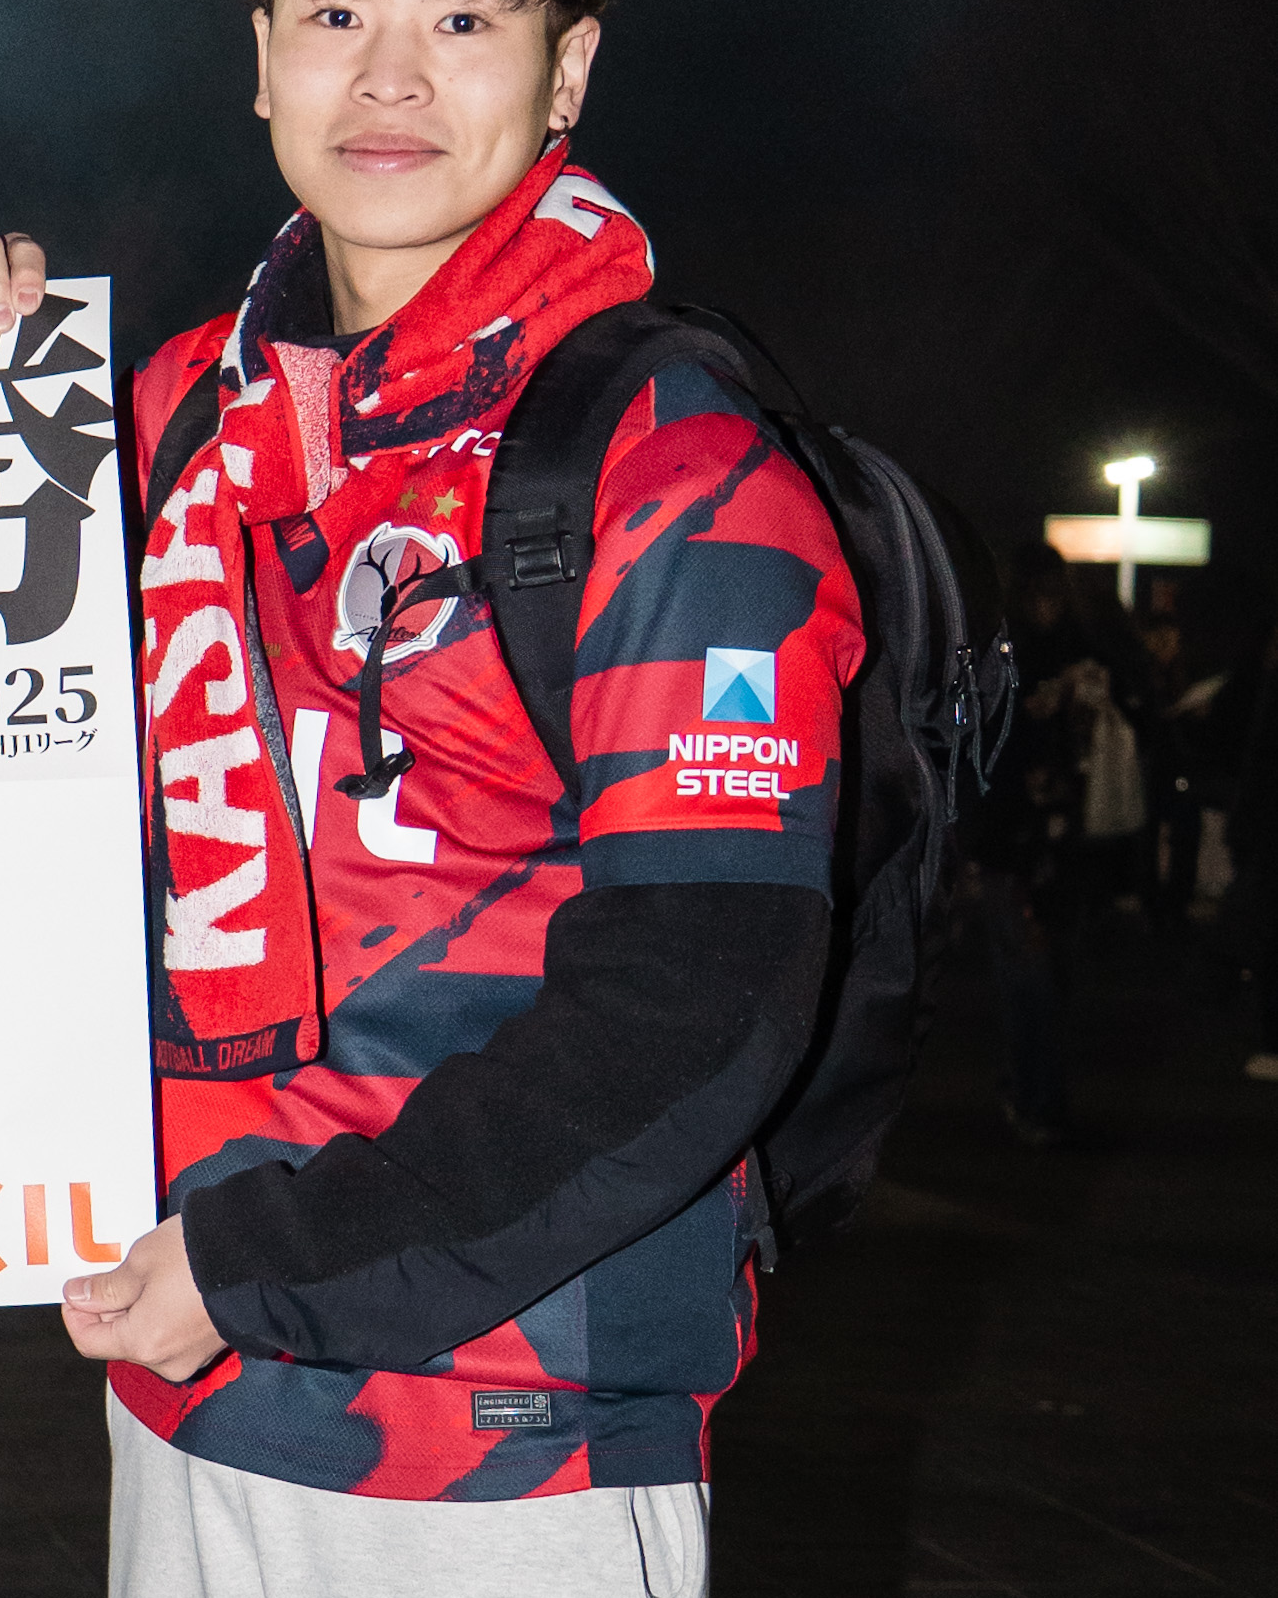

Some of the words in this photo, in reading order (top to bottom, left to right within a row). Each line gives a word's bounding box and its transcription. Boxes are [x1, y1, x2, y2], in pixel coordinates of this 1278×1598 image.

[668, 733, 799, 767] NIPPON
[675, 768, 791, 801] STEEL
[217, 1028, 278, 1072] DREAM
